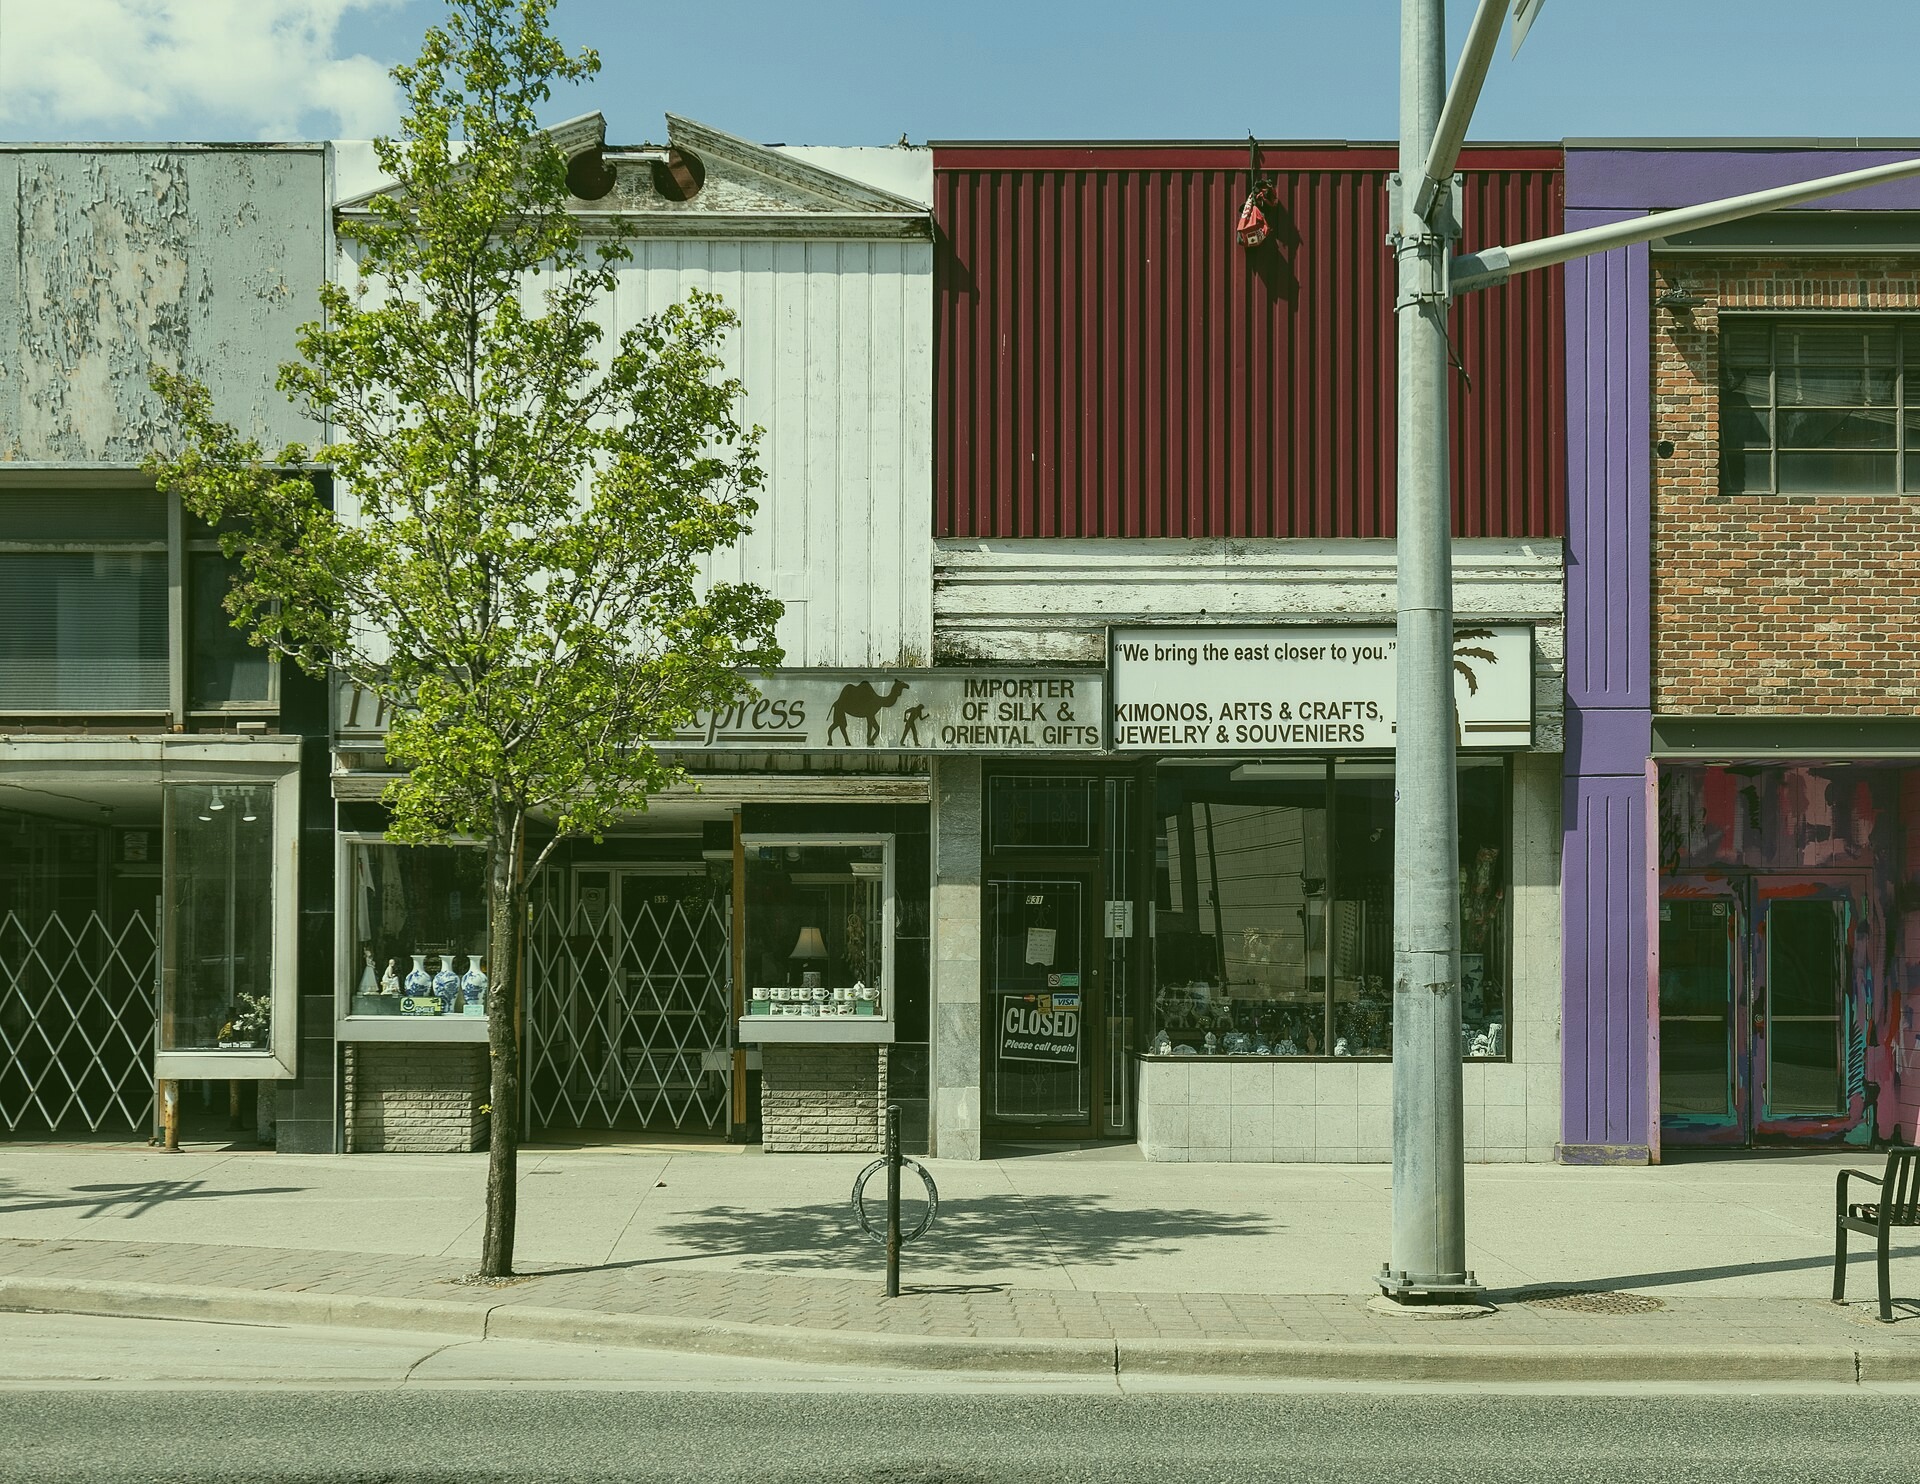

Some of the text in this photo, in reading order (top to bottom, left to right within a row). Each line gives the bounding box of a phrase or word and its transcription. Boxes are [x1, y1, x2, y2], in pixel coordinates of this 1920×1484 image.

[1114, 642, 1396, 665] “We bring the east closer to you.”
[964, 678, 1075, 698] IMPORTER
[962, 701, 1076, 722] OF SILK &
[1114, 701, 1383, 724] KIMONOS, ARTS & CRAFTS,
[941, 725, 1099, 745] ORIENTAL GIFTS
[1114, 724, 1365, 744] JEWELRY & SOUVENIERS
[1026, 895, 1043, 904] 531
[1057, 998, 1075, 1006] VISA
[1005, 1008, 1077, 1037] CLOSED
[1004, 1039, 1075, 1054] Please call again
